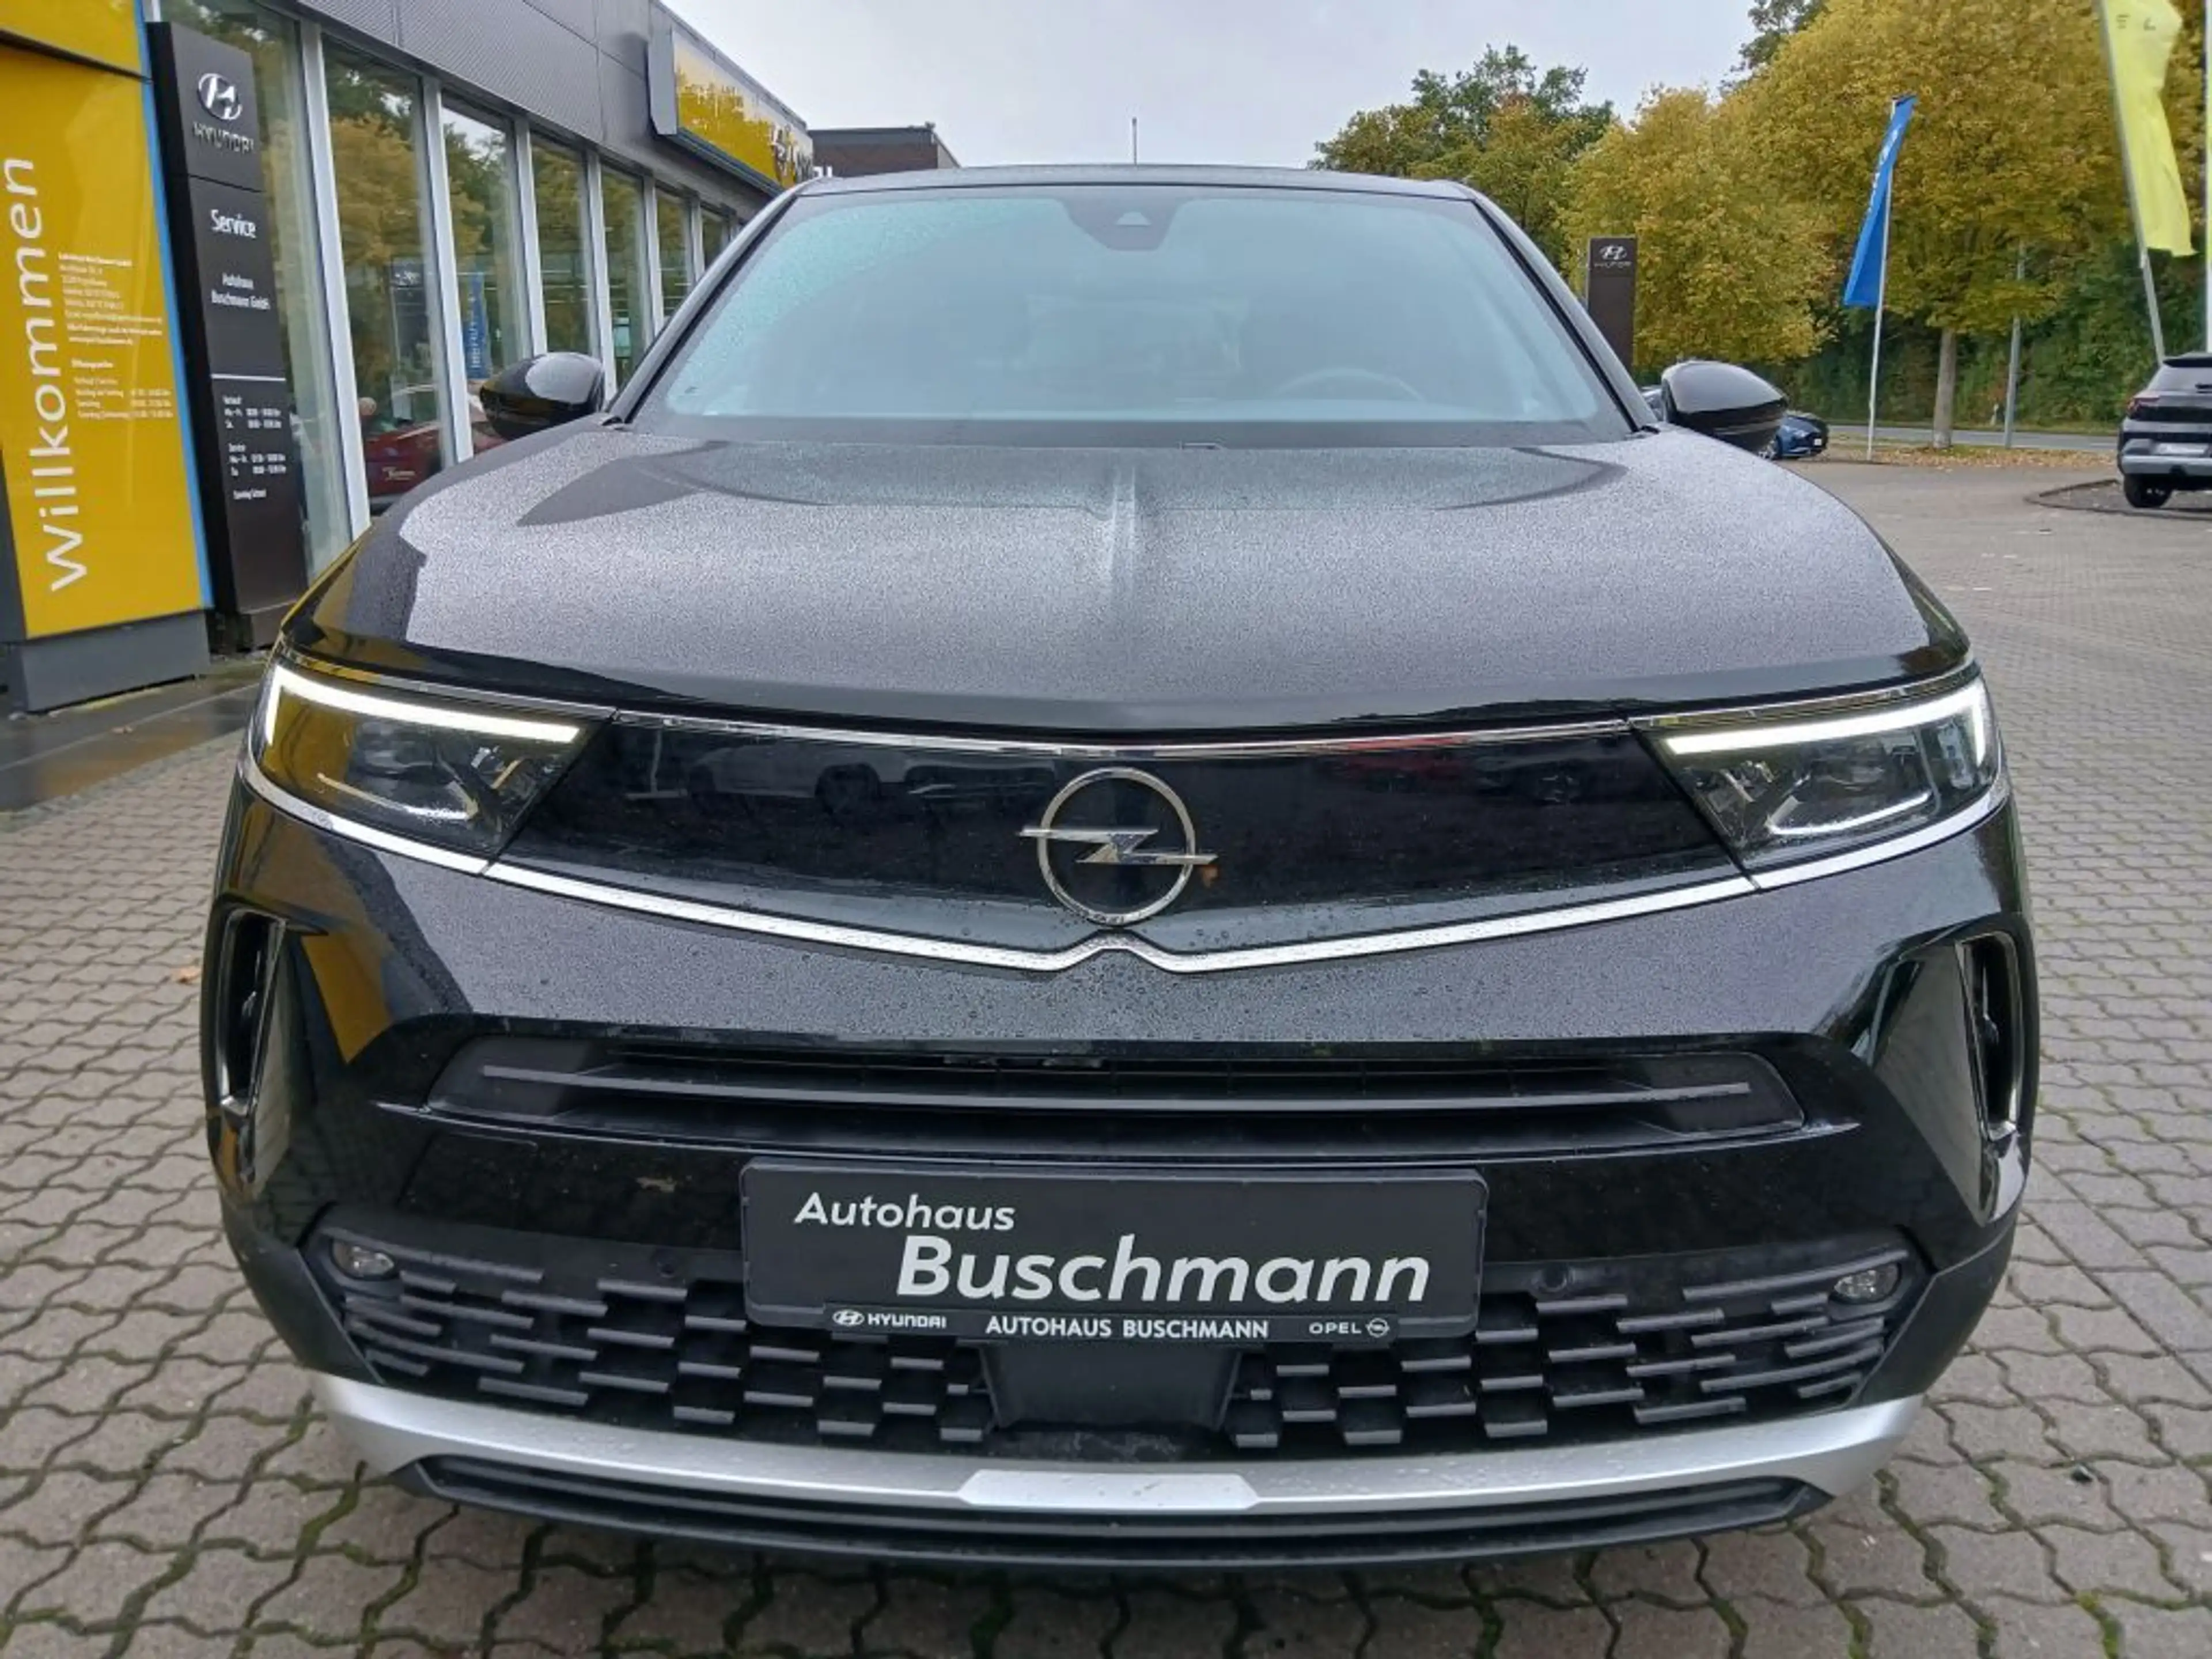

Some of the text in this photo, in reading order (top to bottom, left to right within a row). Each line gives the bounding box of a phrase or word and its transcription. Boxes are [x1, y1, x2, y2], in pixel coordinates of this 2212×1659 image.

[192, 122, 254, 154] HYUNDAI
[210, 209, 257, 239] Service
[3, 158, 88, 592] Willkommen
[794, 1192, 1016, 1230] Autohaus
[896, 1233, 1430, 1303] Buschmann
[867, 1313, 947, 1329] HYUNDAI
[985, 1316, 1268, 1339] AUTOHAUS BUSCHMANN
[1309, 1321, 1362, 1335] OPEL
